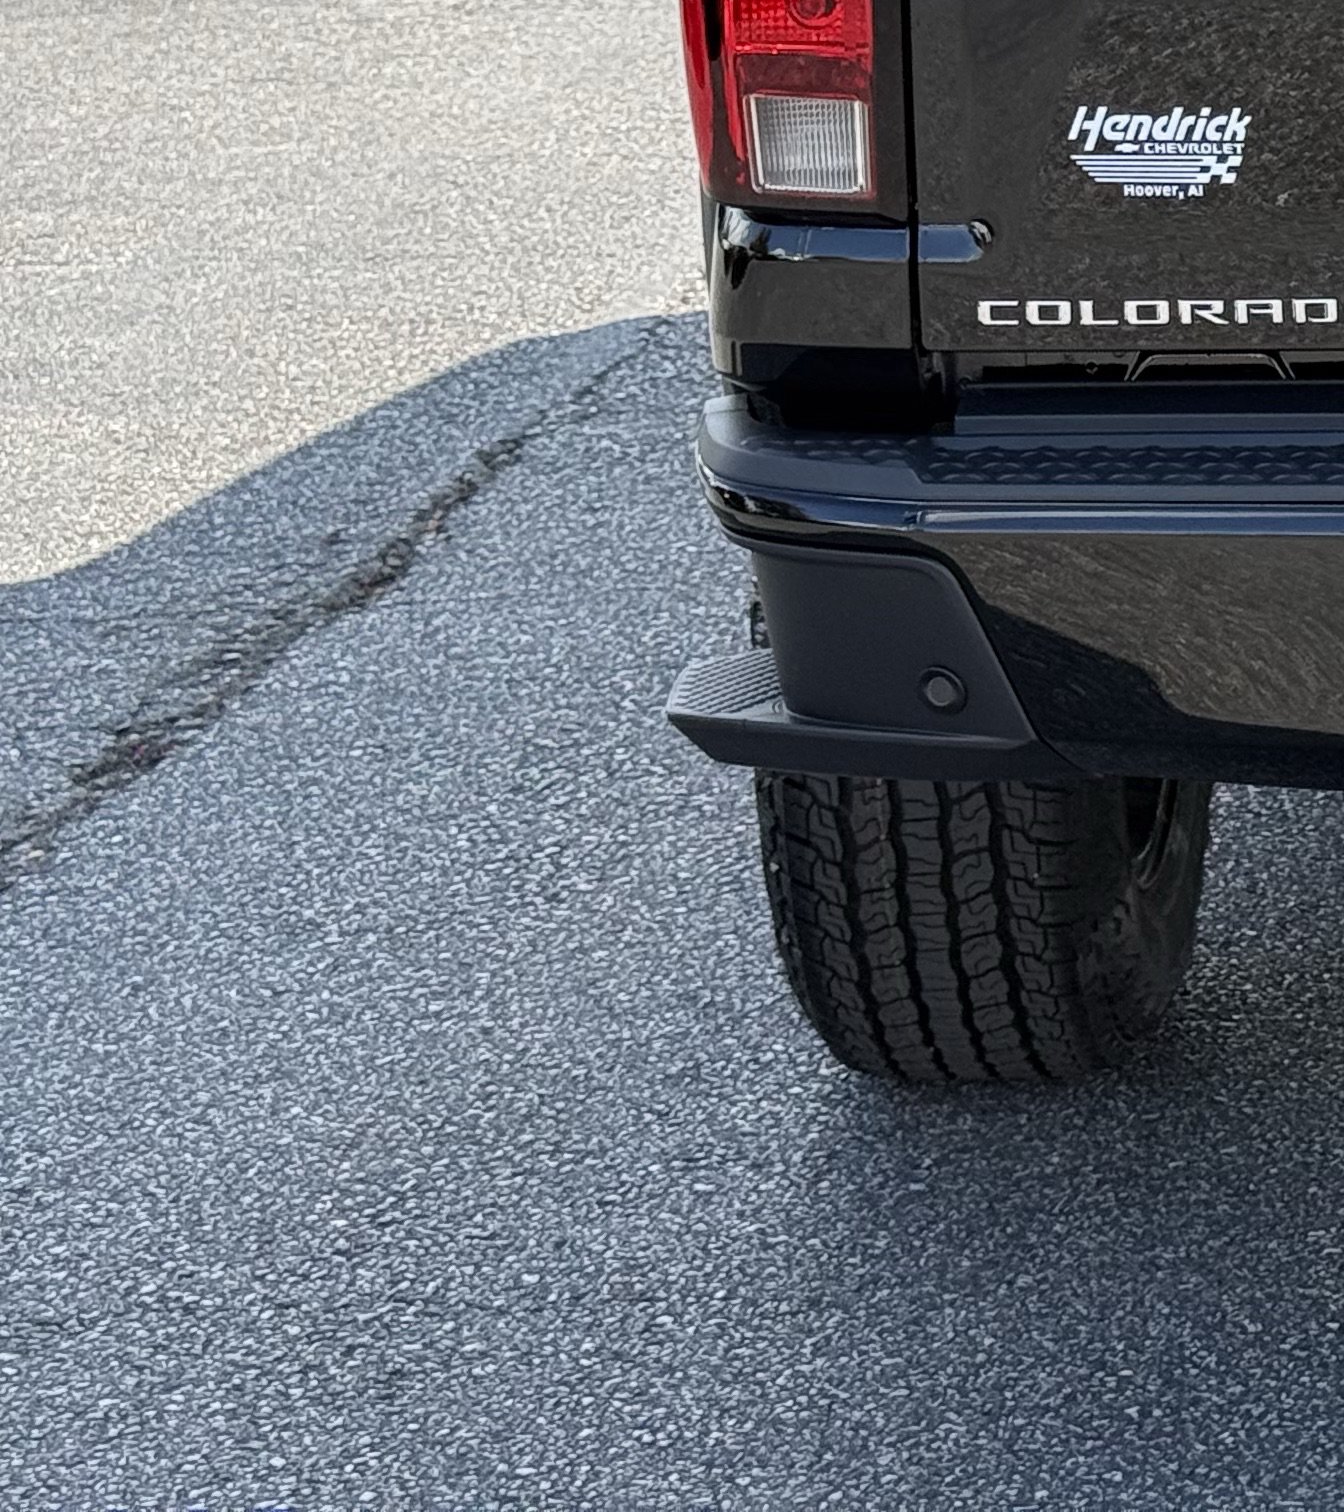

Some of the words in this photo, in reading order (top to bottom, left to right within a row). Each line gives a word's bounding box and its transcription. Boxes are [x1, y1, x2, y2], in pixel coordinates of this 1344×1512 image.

[1067, 105, 1252, 152] Hendrick
[1143, 142, 1245, 155] CHEVROLET
[1123, 184, 1185, 200] Hoover,
